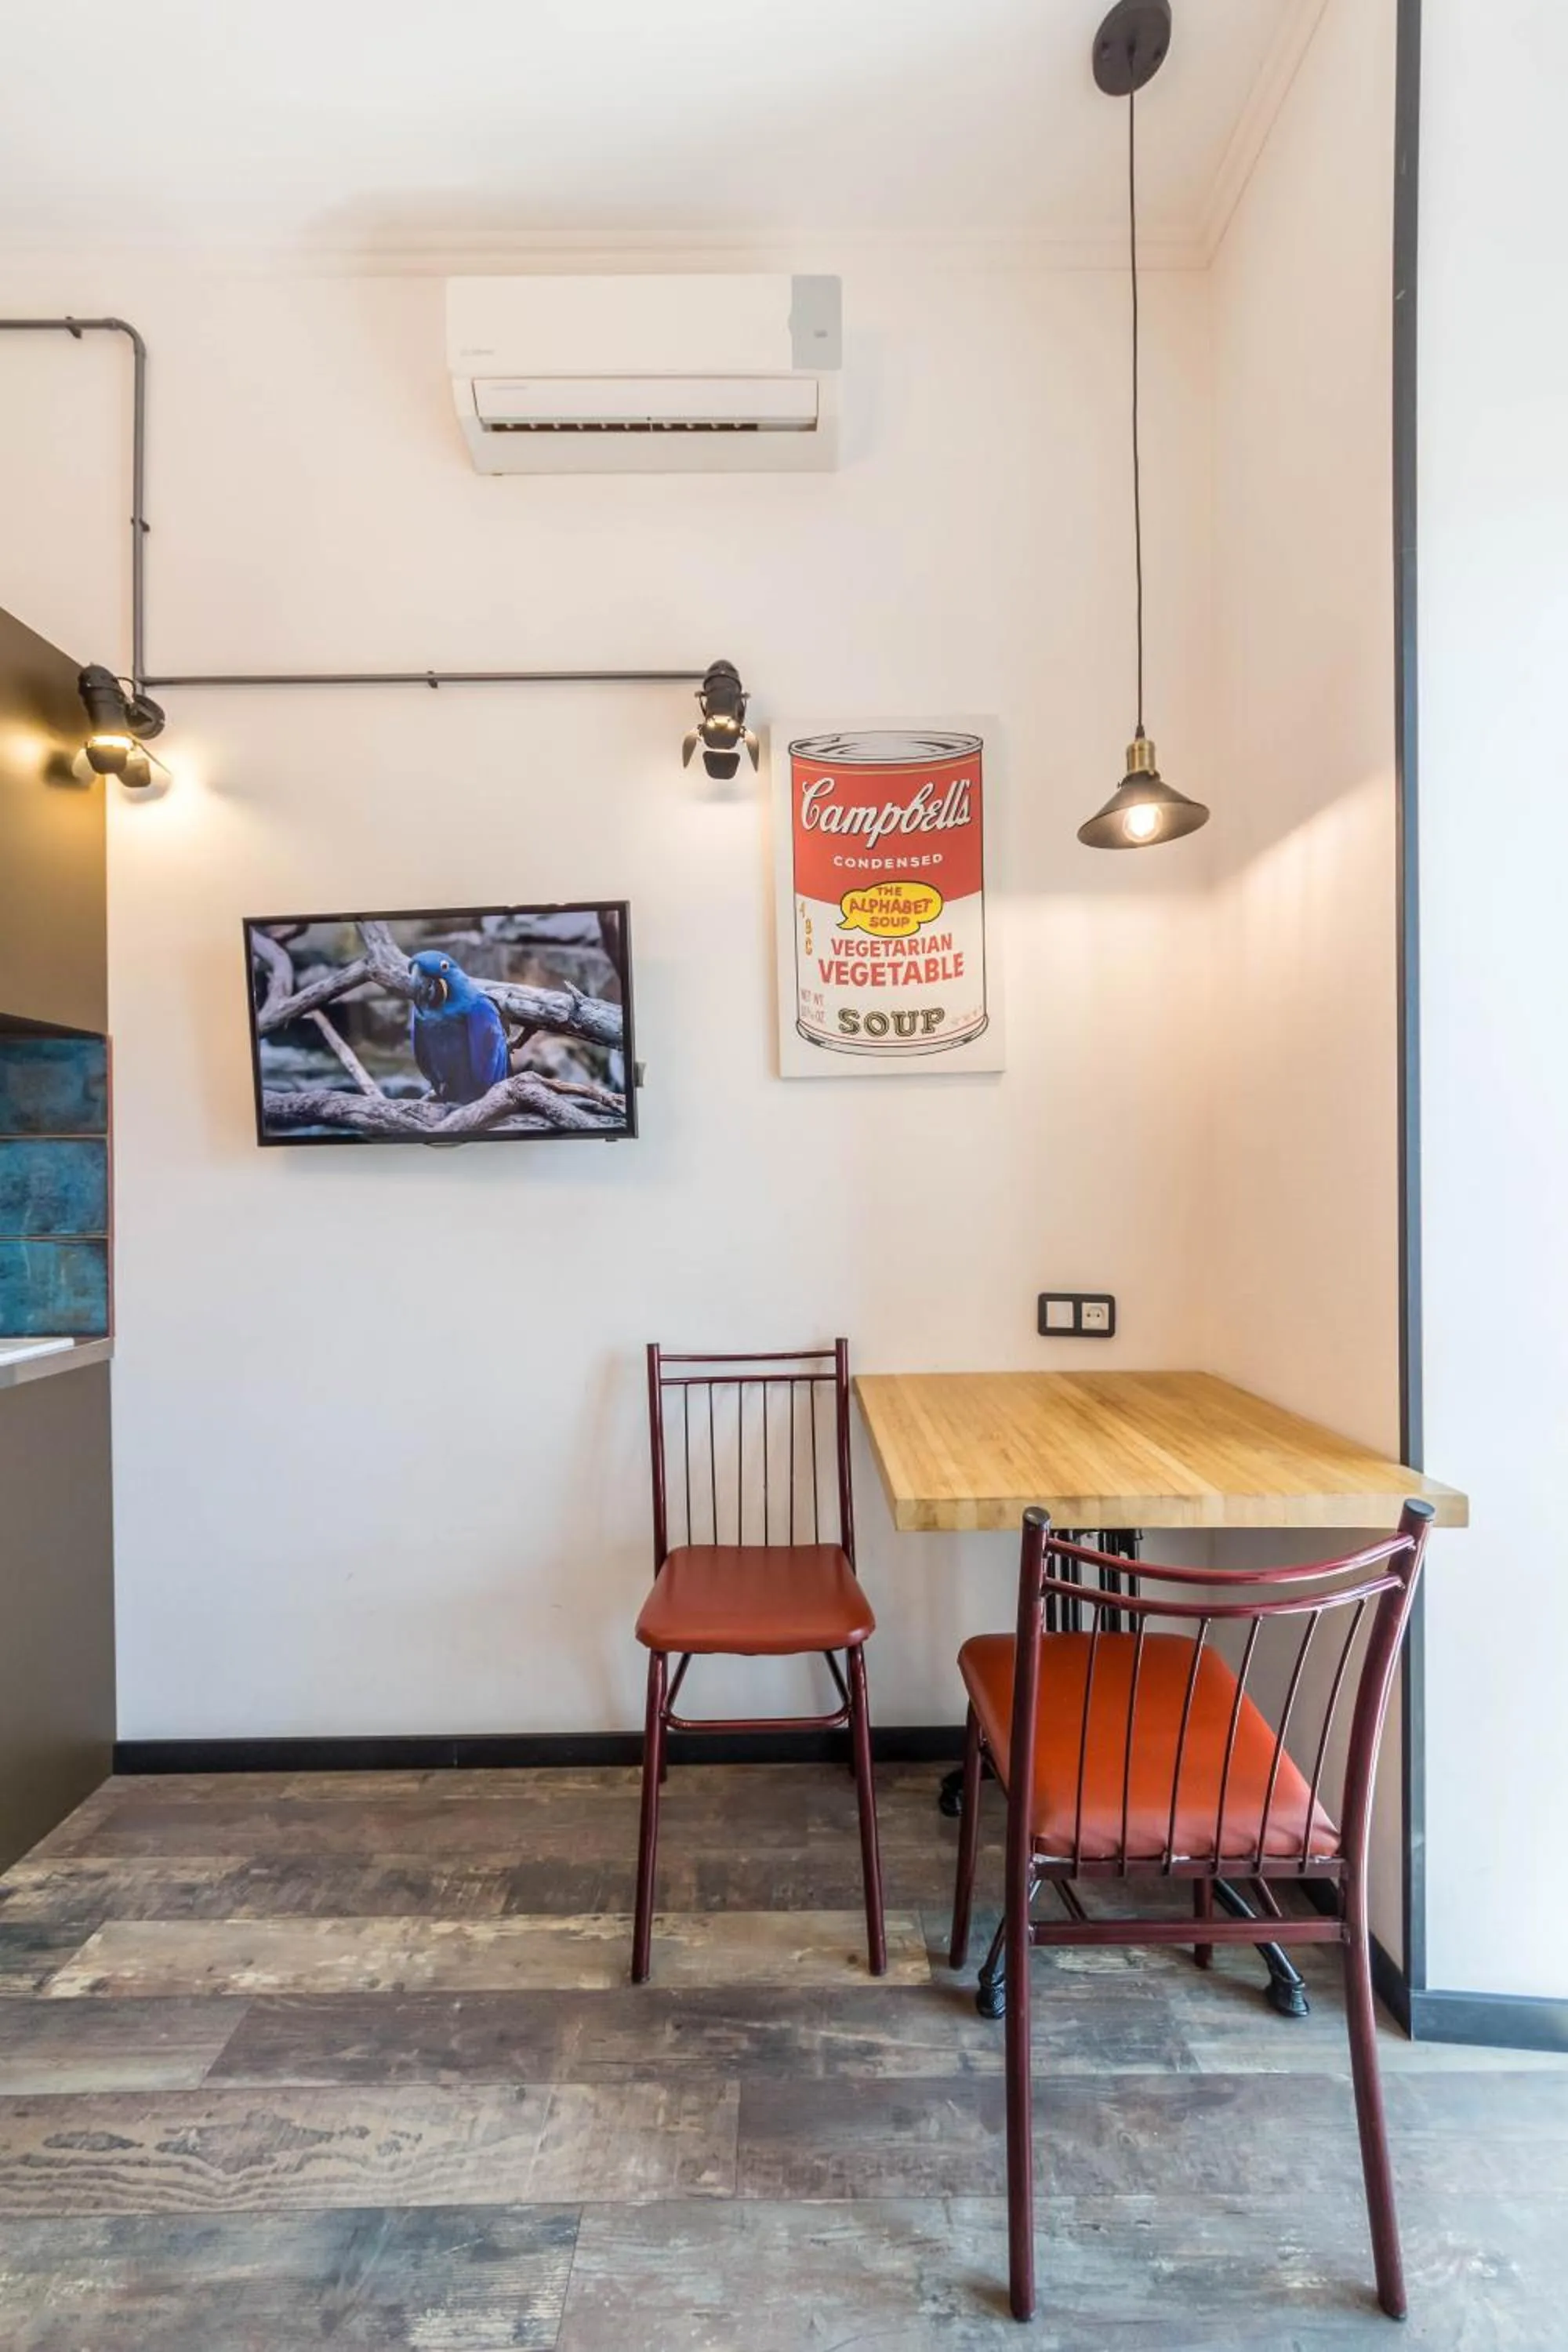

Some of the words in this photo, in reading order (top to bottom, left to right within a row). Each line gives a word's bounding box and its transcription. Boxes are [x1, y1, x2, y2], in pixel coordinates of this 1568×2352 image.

[833, 854, 944, 869] CONDENSED
[876, 887, 902, 896] THE
[849, 898, 934, 914] ALPHABET
[869, 916, 911, 928] SOUP
[831, 933, 953, 957] VEGETARIAN
[818, 953, 964, 986] VEGETABLE
[838, 1007, 946, 1036] SOUP
